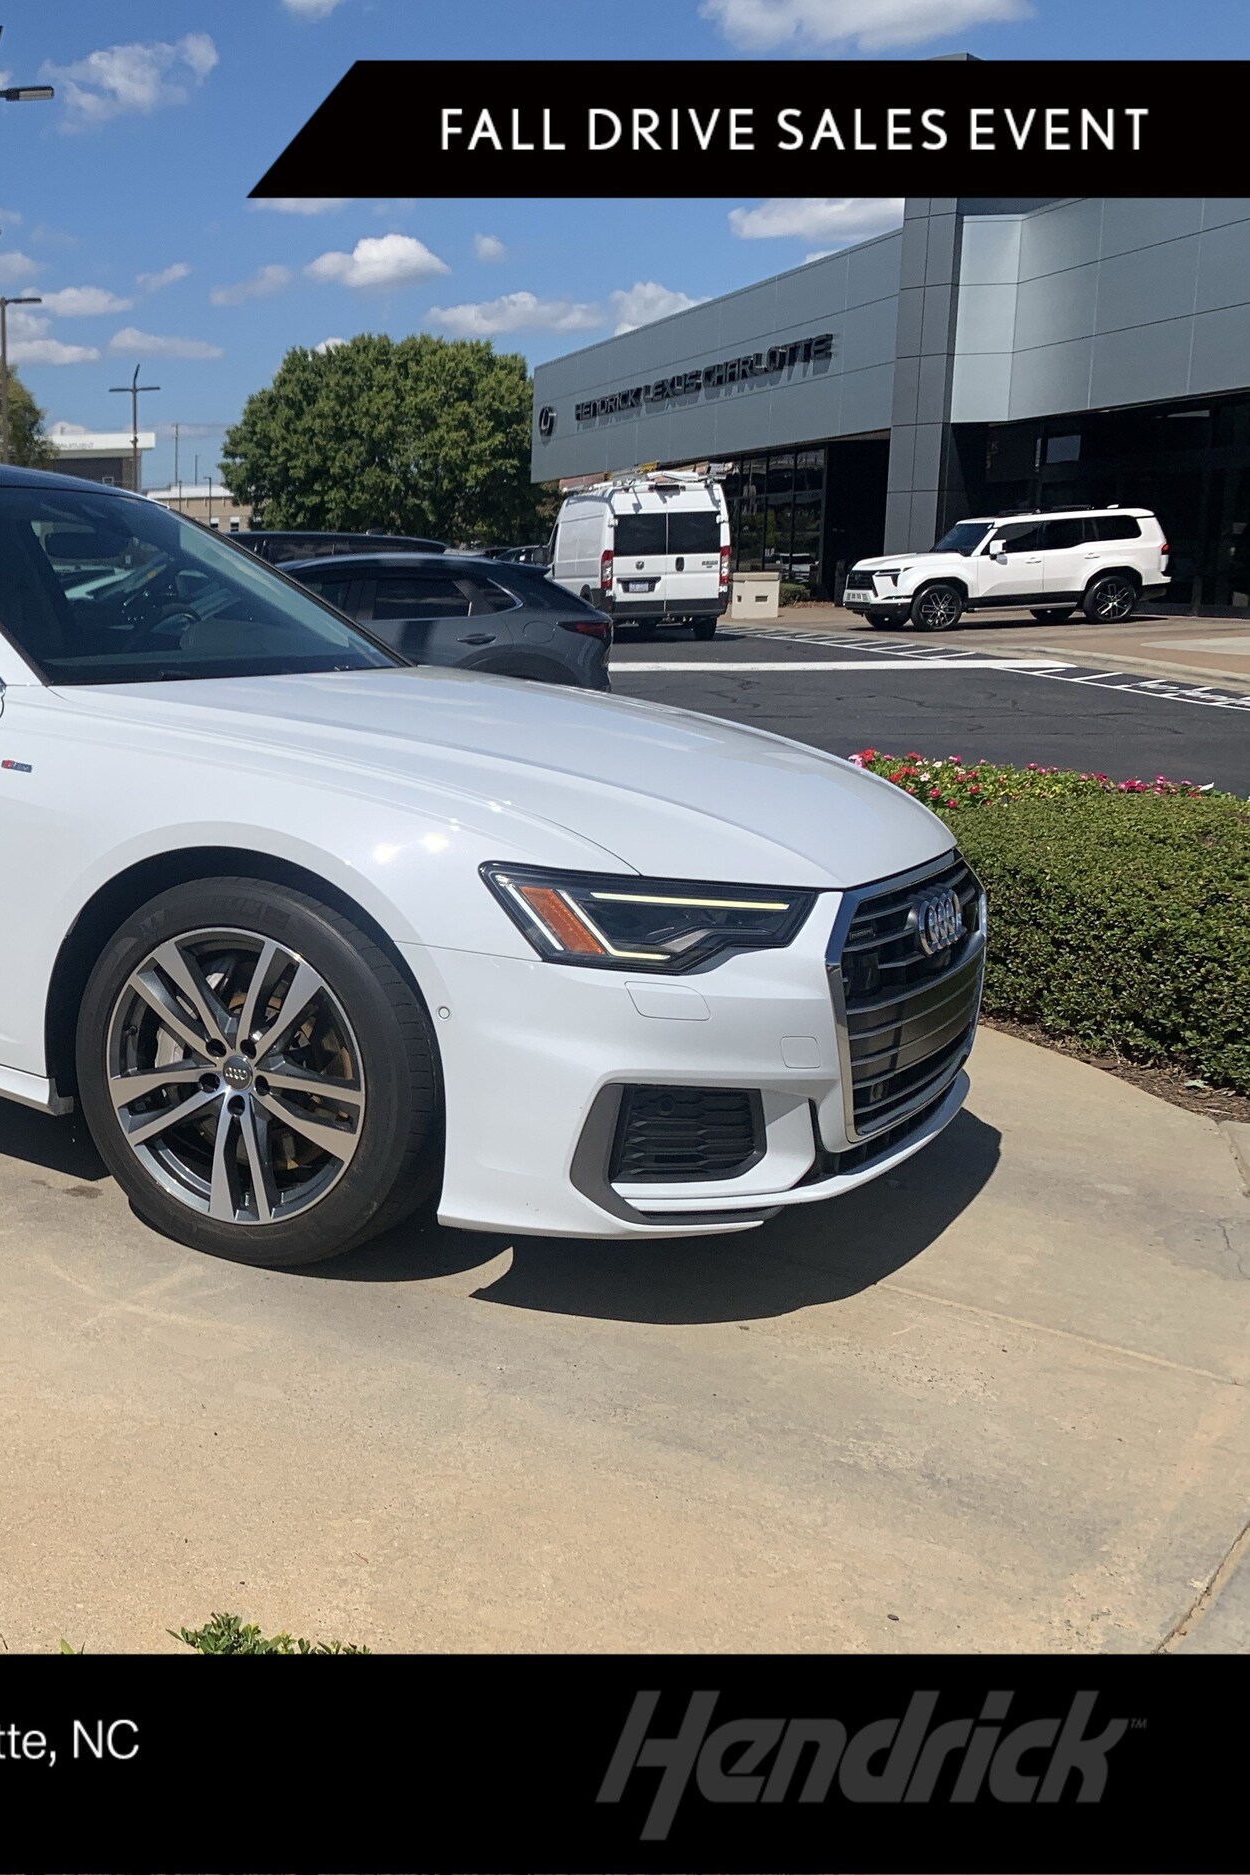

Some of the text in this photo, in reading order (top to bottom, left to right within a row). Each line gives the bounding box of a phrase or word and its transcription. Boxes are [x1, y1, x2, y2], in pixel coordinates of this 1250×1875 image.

[575, 333, 834, 421] HENDRICK LEXUS CHARLOTTE
